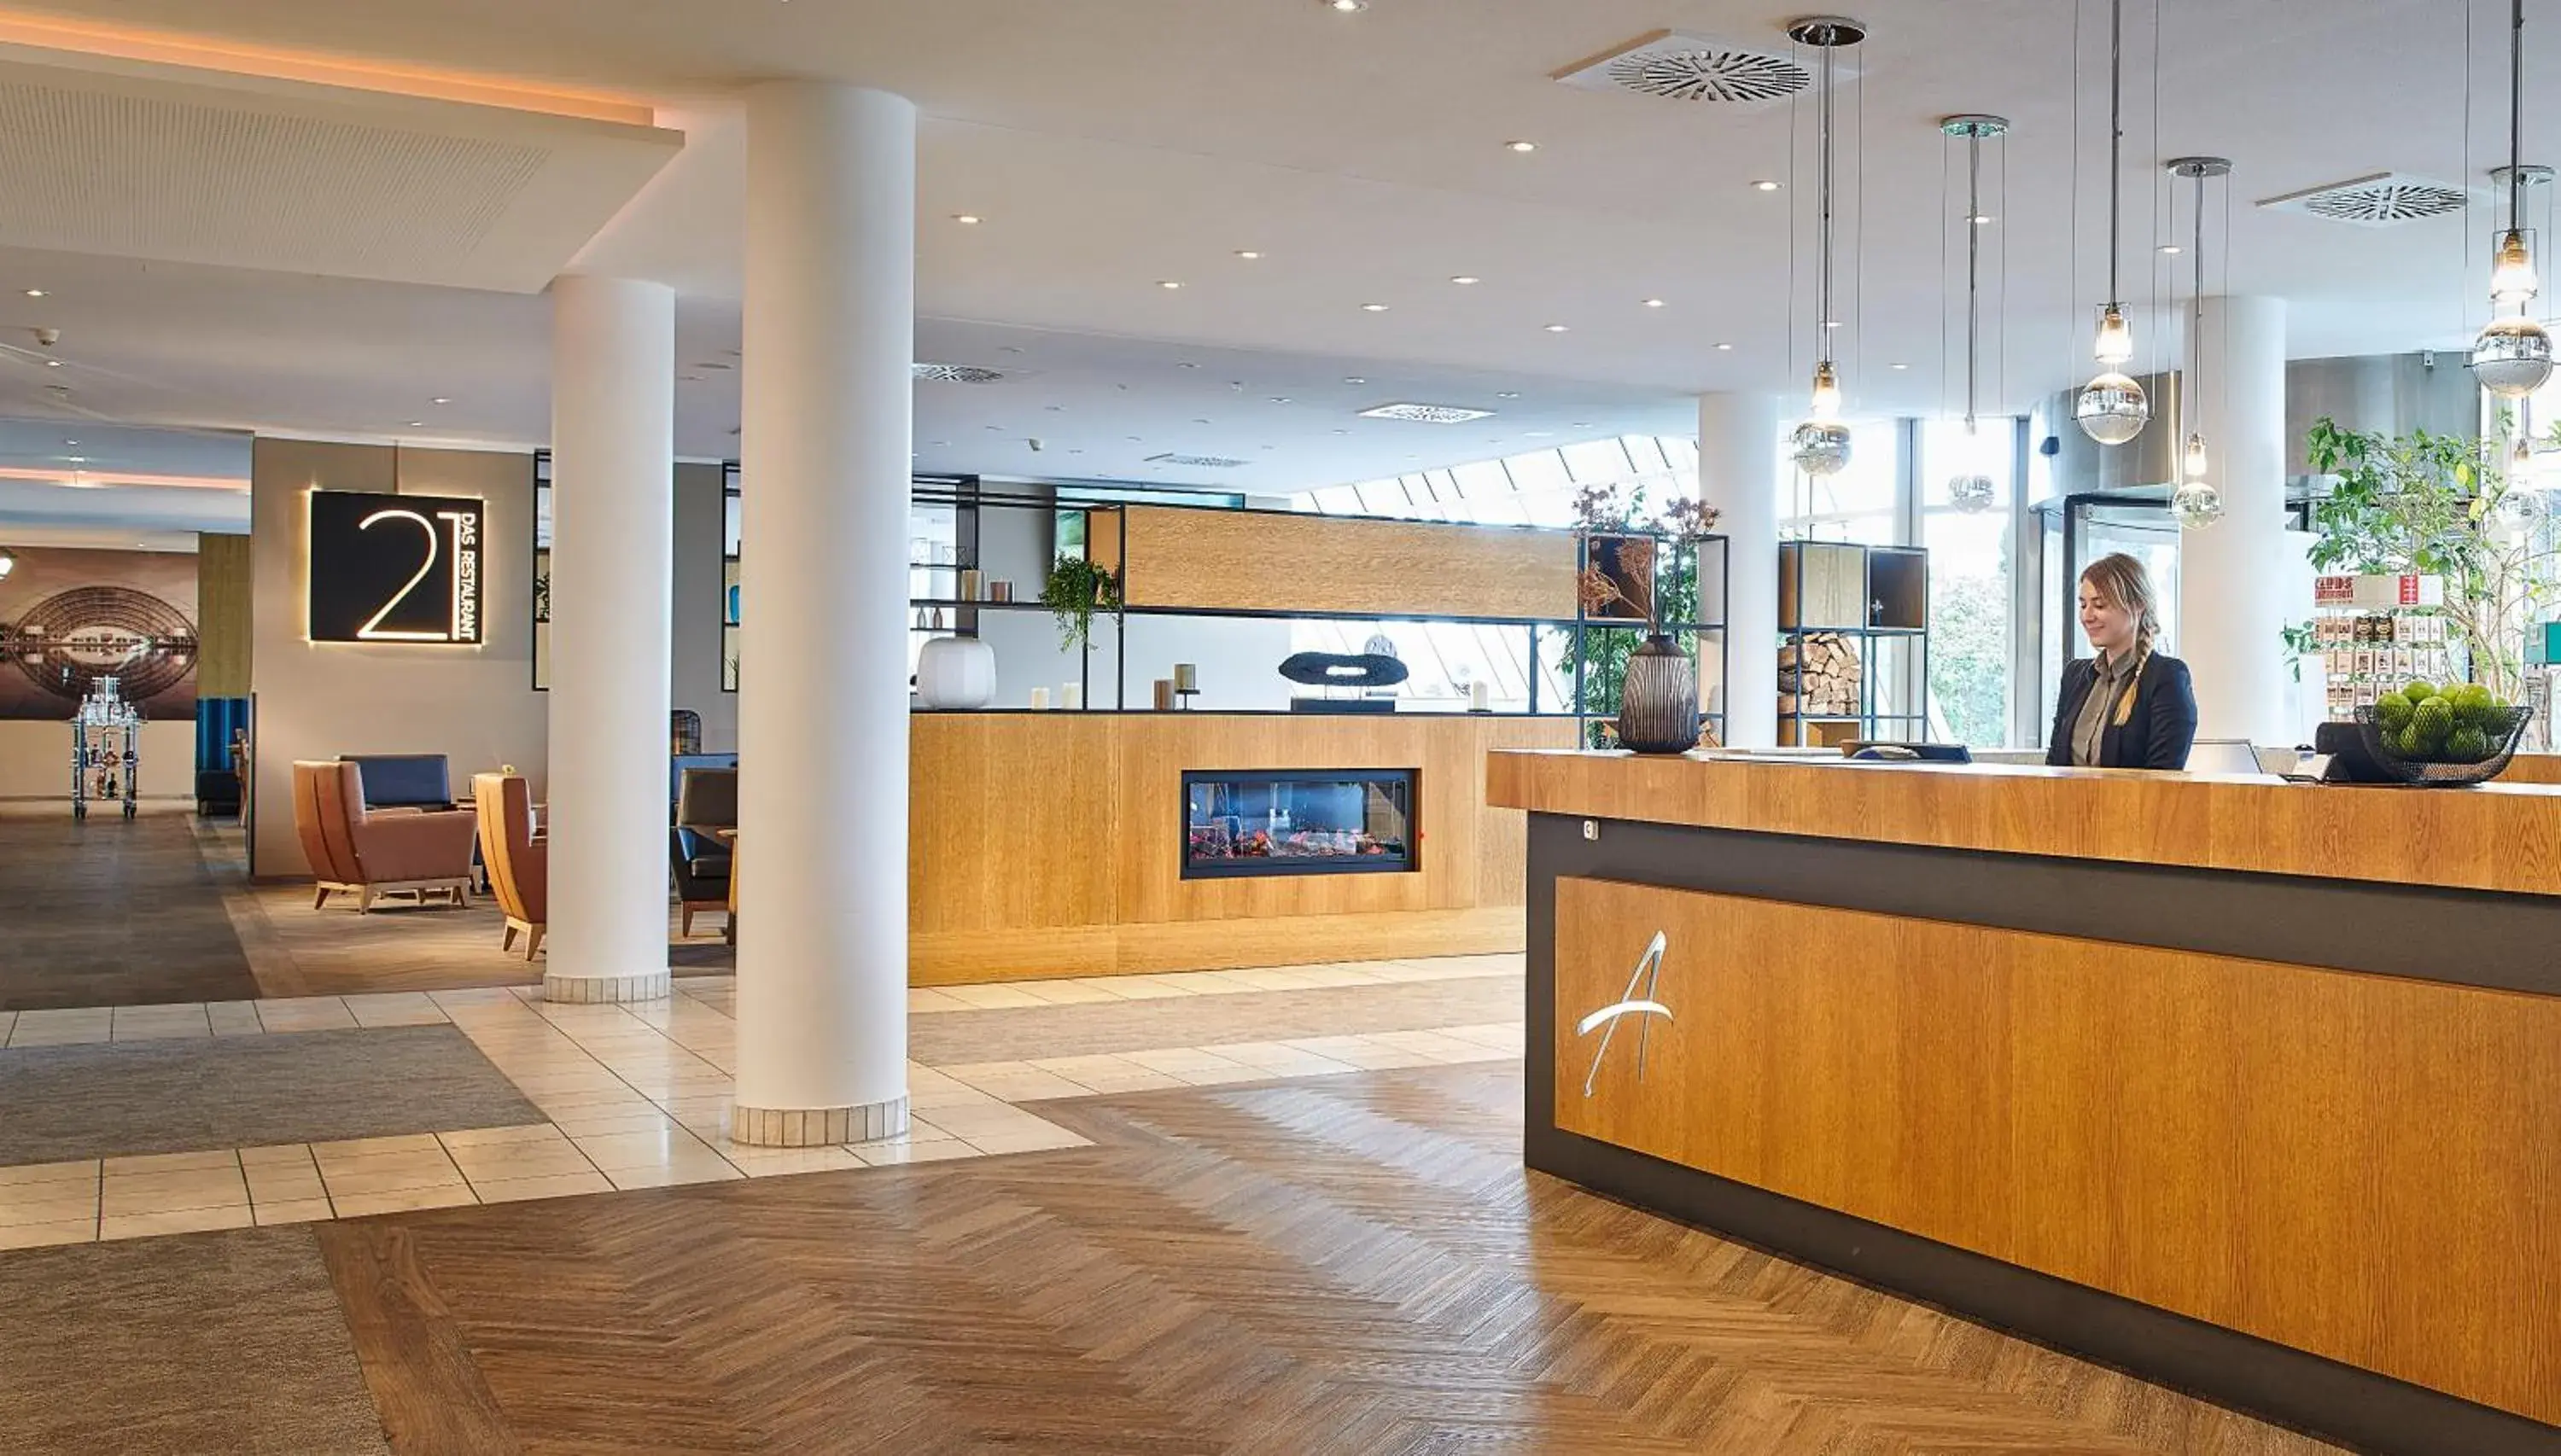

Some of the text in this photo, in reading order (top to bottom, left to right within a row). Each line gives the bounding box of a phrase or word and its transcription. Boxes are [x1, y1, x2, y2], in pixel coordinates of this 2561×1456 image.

[357, 510, 460, 641] 21
[460, 512, 475, 641] DAS RESTAURANT
